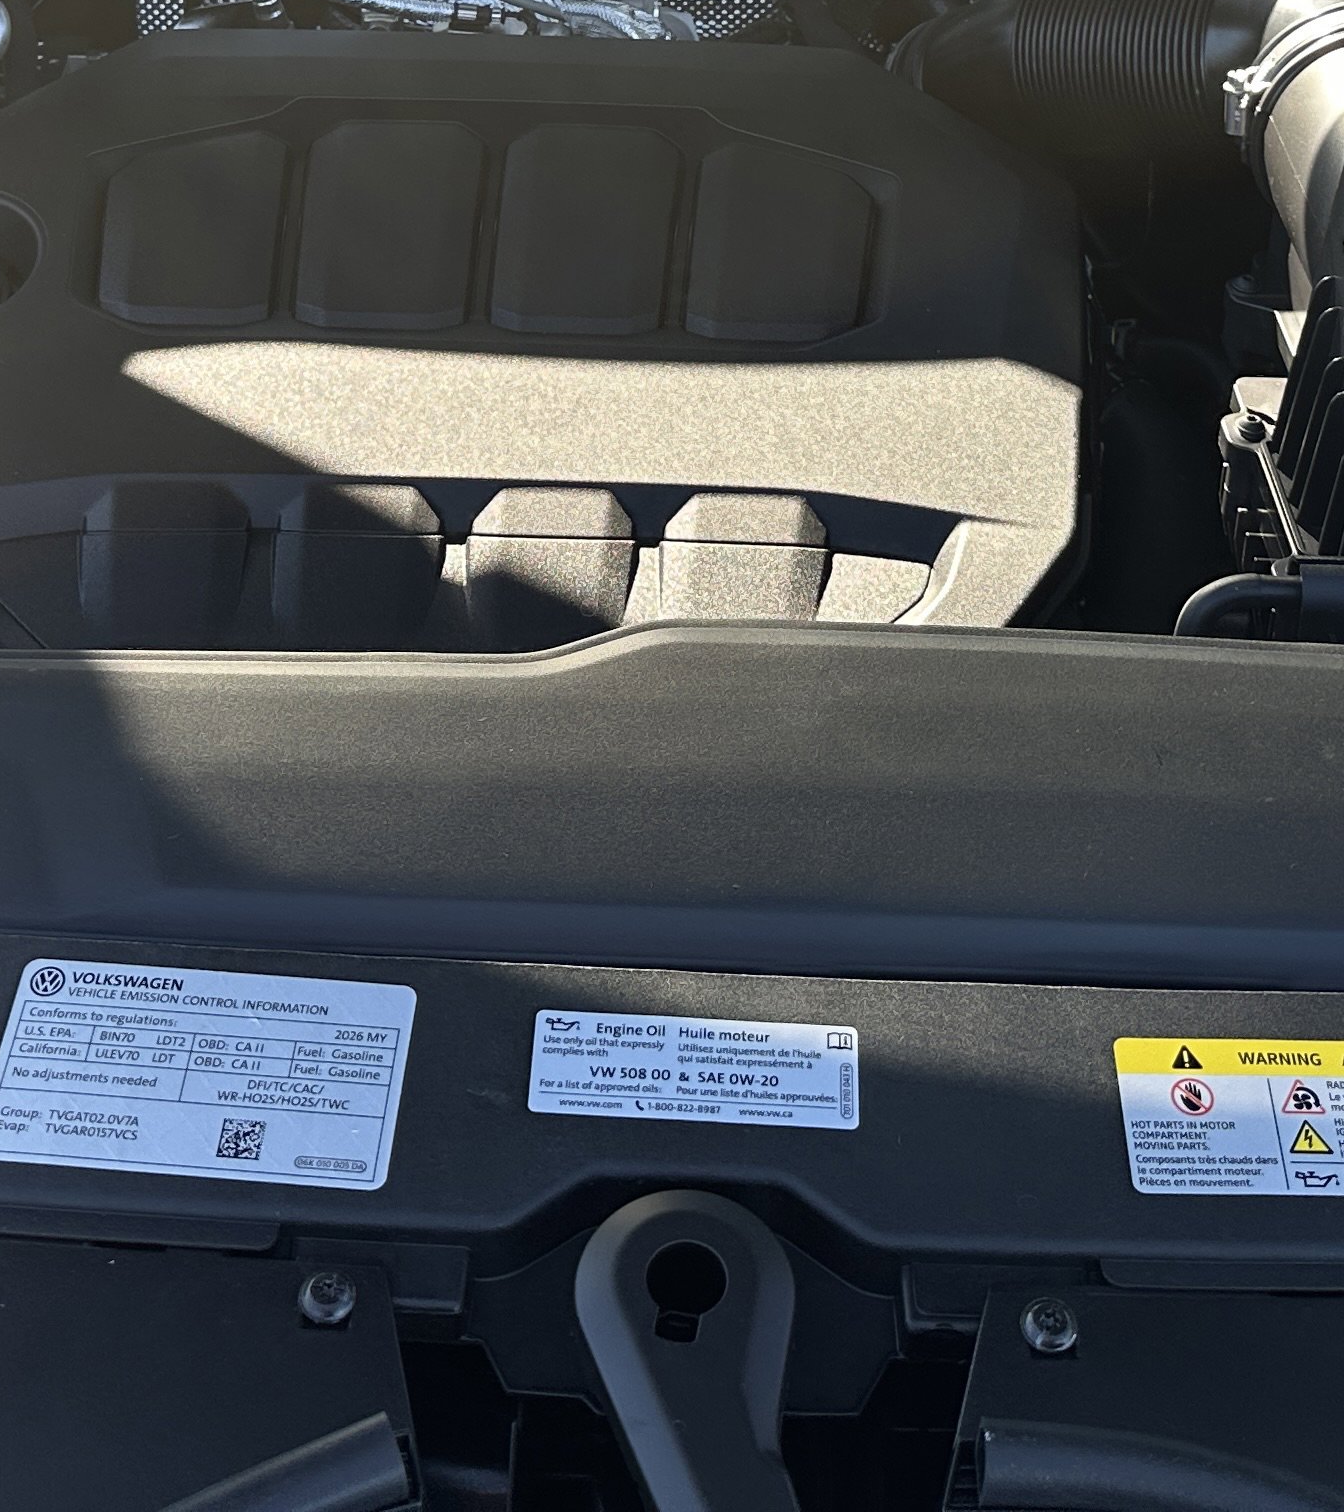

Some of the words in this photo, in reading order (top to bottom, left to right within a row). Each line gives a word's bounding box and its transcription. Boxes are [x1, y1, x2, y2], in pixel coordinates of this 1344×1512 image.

[72, 972, 184, 992] VOLKSWAGEN
[68, 987, 116, 1000] VEHICLE
[120, 990, 179, 1004] EMISSION
[182, 995, 239, 1010] CONTROL
[242, 1000, 329, 1016] INFORMATION
[30, 1006, 87, 1020] Conforms
[91, 1011, 103, 1022] to
[106, 1013, 178, 1028] regulations:
[24, 1026, 46, 1036] U.S.
[49, 1028, 76, 1038] EPA:
[334, 1030, 364, 1042] 2026
[366, 1032, 388, 1044] MY
[596, 1022, 643, 1038] Engine
[646, 1024, 666, 1037] Oil
[679, 1026, 715, 1040] Huile
[718, 1030, 770, 1044] moteur
[100, 1030, 136, 1042] BIN70
[156, 1035, 186, 1047] LDT2
[198, 1039, 230, 1052] OBD:
[235, 1042, 253, 1052] CA
[543, 1034, 562, 1044] Use
[563, 1036, 584, 1047] only
[585, 1037, 597, 1046] oil
[599, 1038, 619, 1048] that
[621, 1040, 664, 1052] expressly
[19, 1042, 82, 1056] California:
[95, 1048, 140, 1061] ULEV70
[152, 1052, 176, 1064] LDT
[297, 1046, 326, 1058] Fuel:
[331, 1048, 384, 1063] Gasoline
[542, 1046, 585, 1057] complies
[586, 1048, 608, 1058] with
[716, 1046, 776, 1059] uniquement
[778, 1048, 790, 1058] de
[194, 1056, 225, 1068] OBD:
[231, 1059, 248, 1070] CA
[677, 1054, 694, 1065] qui
[1238, 1052, 1322, 1066] WARNING
[12, 1066, 30, 1078] No
[32, 1068, 109, 1086] adjustments
[112, 1074, 158, 1088] needed
[293, 1064, 322, 1076] Fuel:
[328, 1066, 381, 1081] Gasoline
[590, 1065, 616, 1078] VW
[620, 1067, 647, 1080] 508
[651, 1069, 671, 1080] 00
[678, 1072, 690, 1082] &
[698, 1072, 725, 1084] SAE
[729, 1073, 779, 1088] 0W-20
[247, 1080, 326, 1095] DFI/TC/CAC/
[540, 1078, 555, 1088] For
[565, 1080, 580, 1090] list
[582, 1080, 594, 1090] of
[594, 1082, 640, 1094] approved
[676, 1086, 698, 1096] Pour
[700, 1088, 718, 1098] une
[720, 1088, 740, 1098] liste
[218, 1090, 350, 1110] WR-HO2S/HO2S/TWC
[1329, 1092, 1342, 1102] Le
[0, 1106, 42, 1120] Group:
[1131, 1120, 1151, 1130] HOT
[1154, 1120, 1184, 1130] PARTS
[1186, 1121, 1197, 1130] IN
[1200, 1121, 1236, 1130] MOTOR
[1134, 1142, 1174, 1150] MOVING
[1136, 1154, 1196, 1166] Composants
[1198, 1154, 1216, 1164] très
[1218, 1155, 1252, 1164] chauds
[1254, 1156, 1278, 1165] dans
[1138, 1166, 1146, 1175] le
[1149, 1166, 1222, 1178] compartiment
[1140, 1176, 1172, 1186] Pièces
